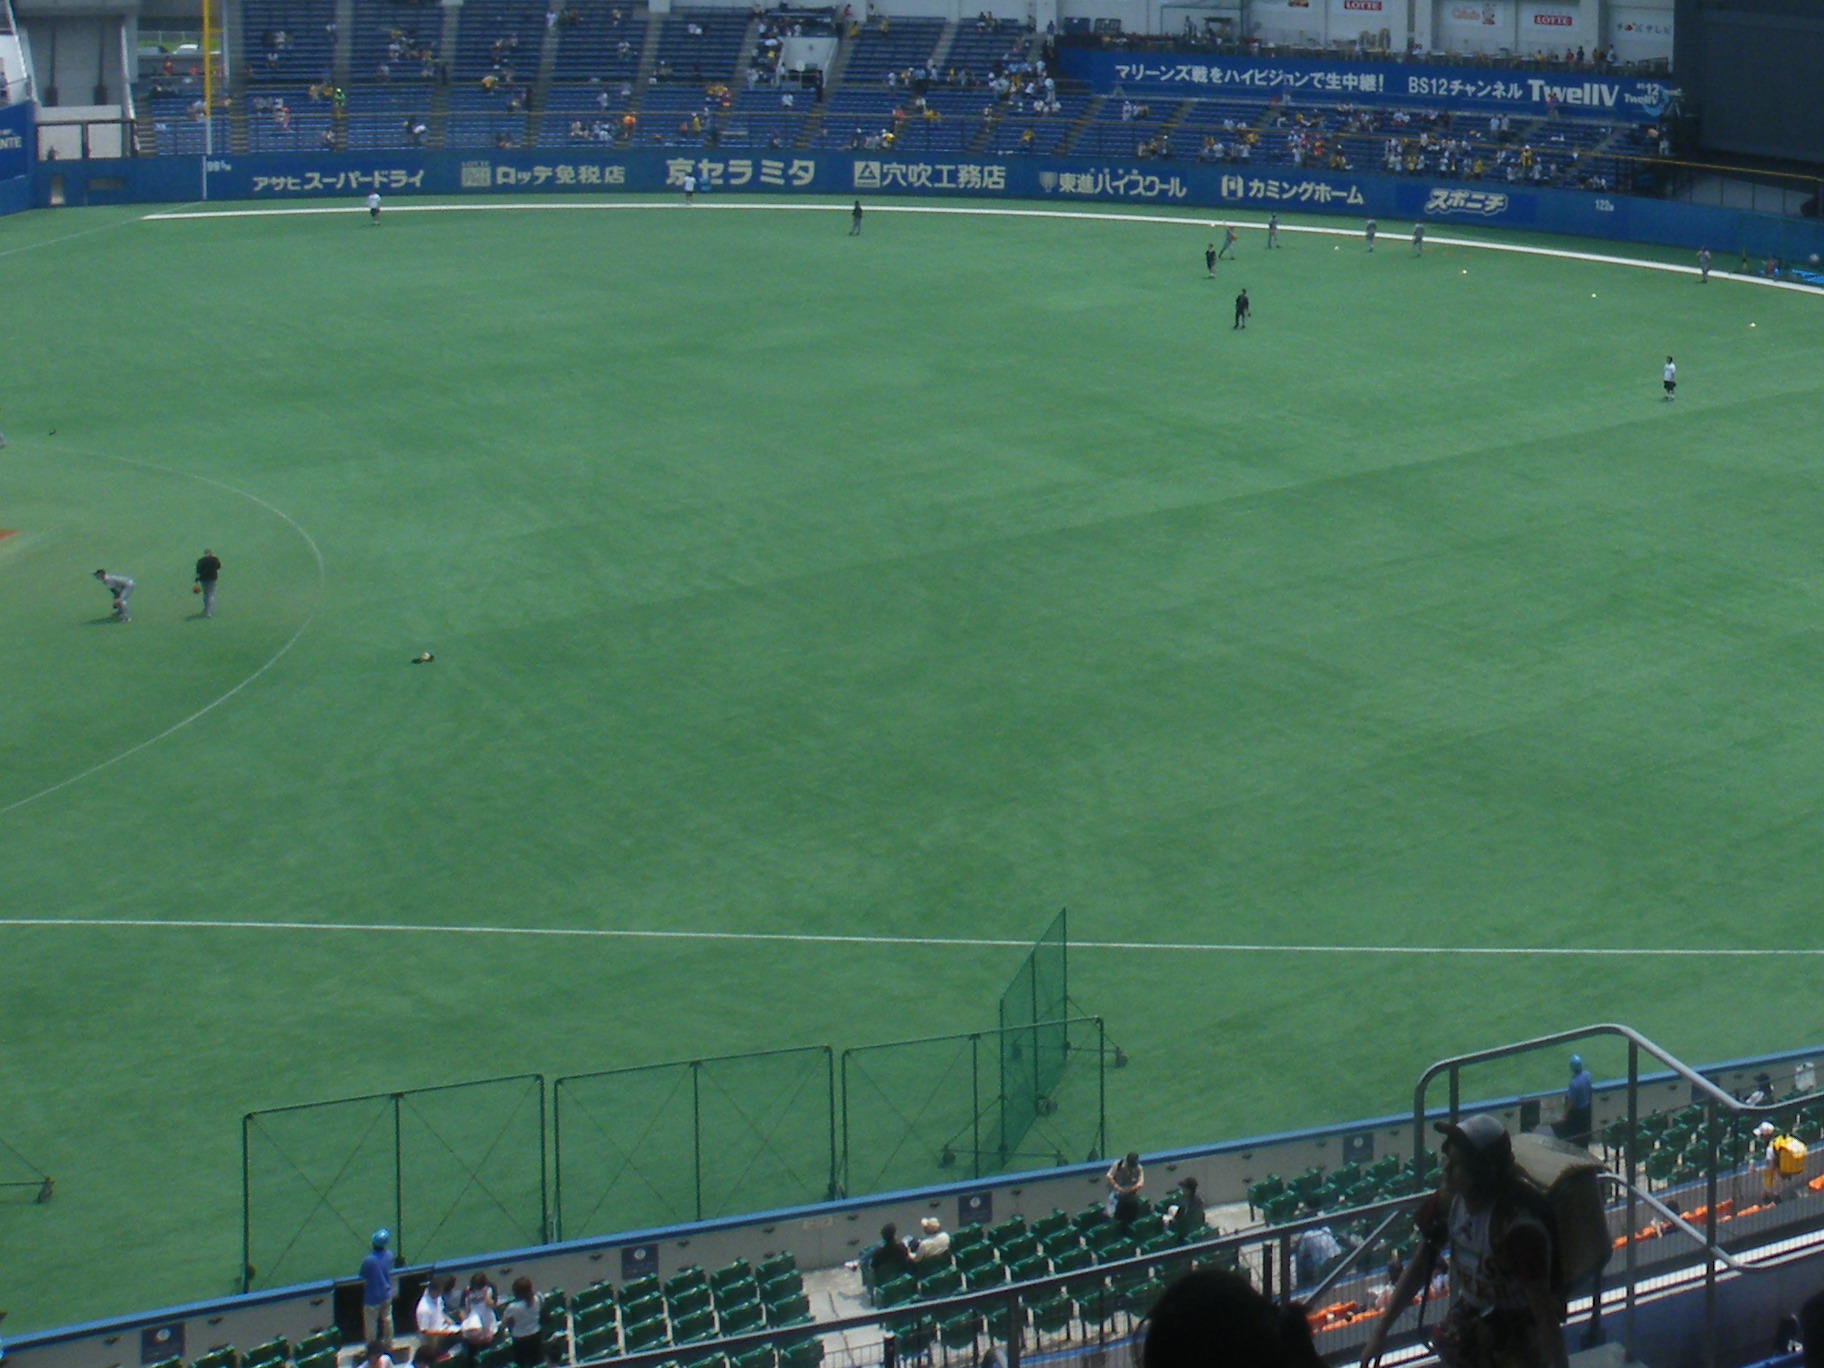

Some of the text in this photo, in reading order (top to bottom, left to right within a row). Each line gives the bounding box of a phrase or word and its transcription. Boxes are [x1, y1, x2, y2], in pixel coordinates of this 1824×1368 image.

[1345, 0, 1381, 10] LOTTE
[1535, 15, 1571, 25] LOTTE
[1527, 79, 1620, 107] TwellV
[496, 165, 626, 185] ロッテ免税店
[666, 158, 816, 186] 京セラミタ
[882, 163, 1006, 190] 穴吹工務店
[1058, 170, 1187, 199] 東進ハイスクール
[1248, 178, 1364, 206] カミングホーム
[1425, 187, 1508, 215] スポニチ
